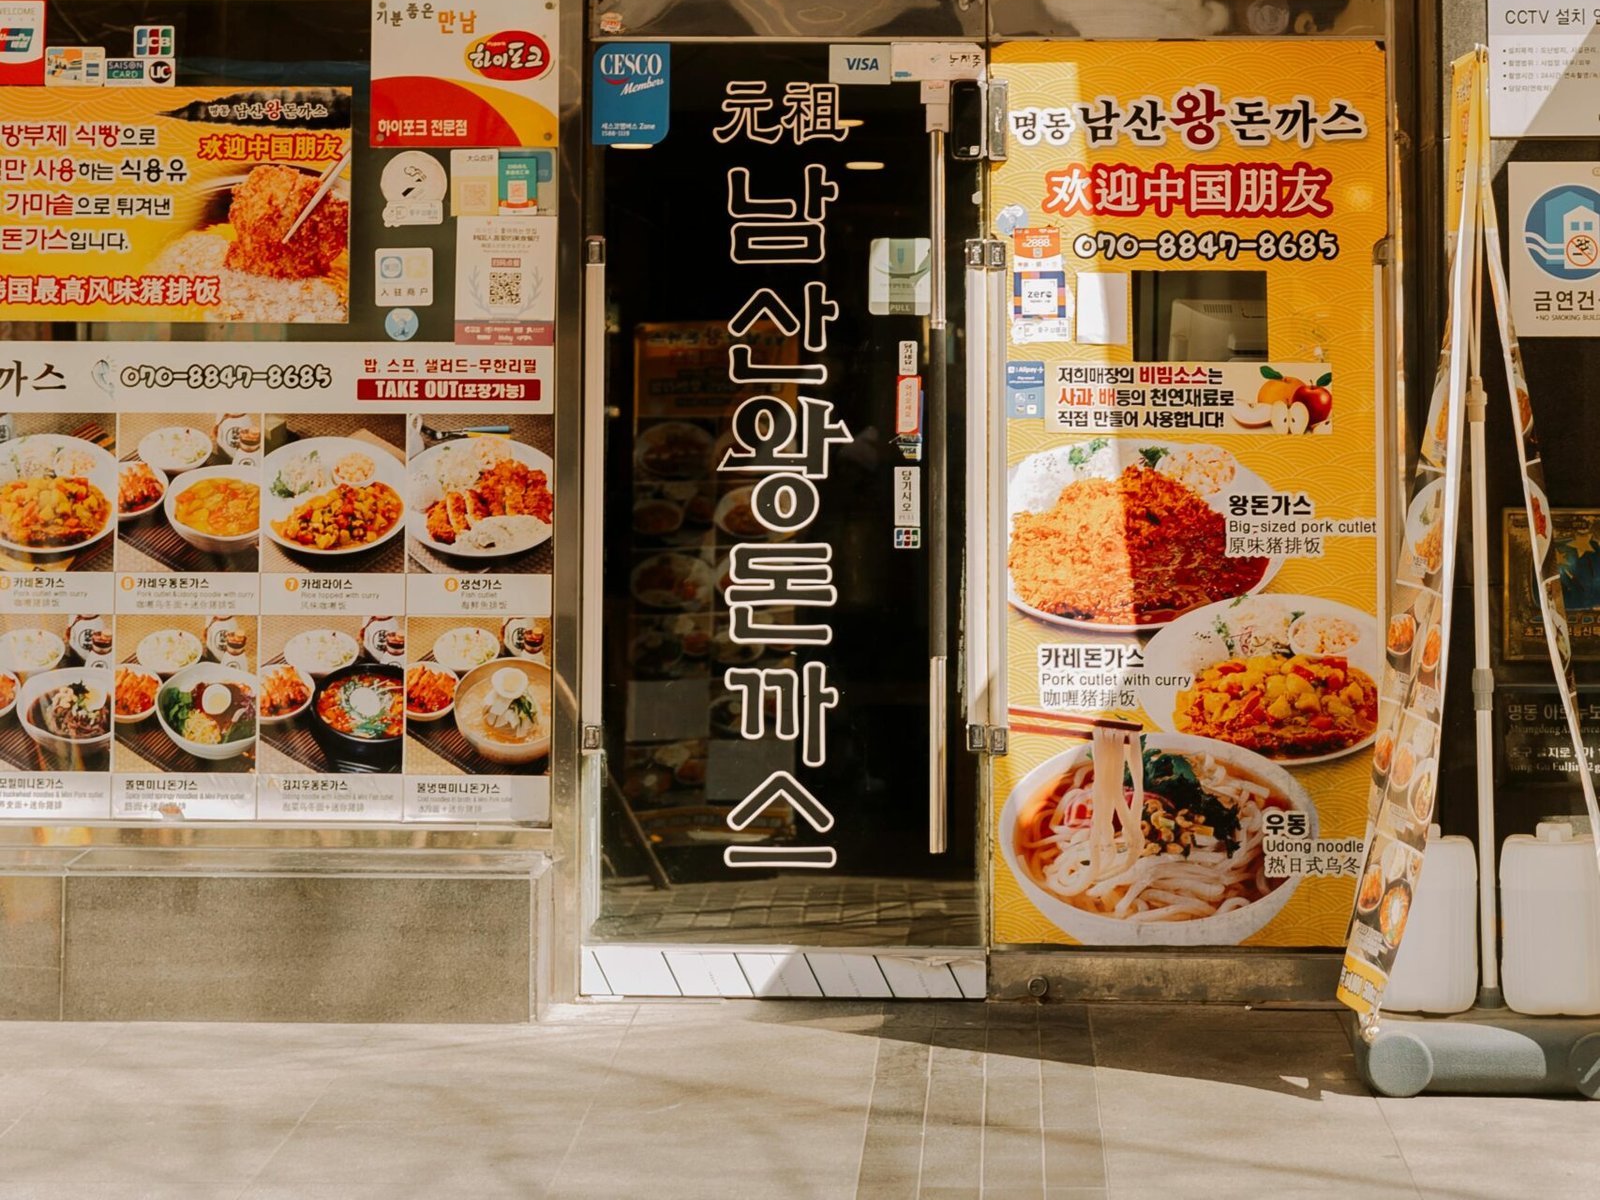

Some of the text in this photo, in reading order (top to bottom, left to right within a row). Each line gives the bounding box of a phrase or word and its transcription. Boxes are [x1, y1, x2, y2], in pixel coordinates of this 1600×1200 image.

[376, 3, 478, 34] 기분 좋은 만남
[1505, 10, 1549, 25] CCTV
[1556, 8, 1586, 26] 설치
[137, 29, 172, 55] JCB
[469, 40, 544, 69] 하이포크
[600, 53, 662, 75] CESCO
[845, 58, 879, 70] VISA
[109, 61, 143, 69] SAISON
[112, 70, 139, 78] CARD
[620, 76, 664, 96] Members
[233, 100, 328, 120] 남산왕돈까스
[713, 81, 848, 145] 元祖
[1013, 89, 1363, 145] 명동 남산왕돈까스
[1, 124, 156, 147] 방부제 식빵으로
[378, 119, 468, 137] 하이포크 전문점
[200, 136, 342, 159] 欢迎中国朋友
[0, 158, 187, 182] 만 사용하는 식용유
[1047, 167, 1328, 213] 欢迎中国朋友
[6, 193, 171, 217] 가마솥으로 튀겨낸
[2, 228, 129, 251] 돈가스입니다.
[1075, 231, 1339, 261] 070-8847-8685
[890, 304, 911, 312] PULL
[1533, 290, 1600, 312] 금연건
[425, 359, 537, 374] 샐러드-무한리필
[1058, 366, 1135, 384] 저희매장의
[1139, 366, 1223, 385] 비빔소스는
[0, 360, 332, 397] 까스 070-8847-8685
[375, 380, 525, 400] TAKE OUT(포장가능)
[1058, 388, 1234, 407] 사과, 배등의 천연재료로
[1058, 410, 1224, 429] 직접 만들어 사용합니다!
[901, 469, 912, 512] 당기시오
[1229, 495, 1312, 516] 왕돈가스
[717, 164, 854, 869] 남산왕돈까스
[1229, 519, 1377, 535] Big-sized pork cutlet
[1229, 537, 1321, 556] 原味猪排饭
[13, 577, 65, 588] 카레돈가스
[137, 578, 210, 589] 카레우동돈가스
[301, 579, 353, 590] 카레라이스
[460, 579, 502, 590] 생선가스
[1041, 648, 1144, 669] 카레돈가스
[1041, 672, 1191, 689] Pork cutlet with curry
[1508, 704, 1538, 721] 명동
[282, 780, 349, 791] 김치우동돈가스
[417, 782, 500, 794] 물냉면미니돈가스
[1266, 814, 1306, 835] 우동
[1266, 839, 1364, 855] Udong noodle
[1267, 856, 1361, 875] 热日式乌冬
